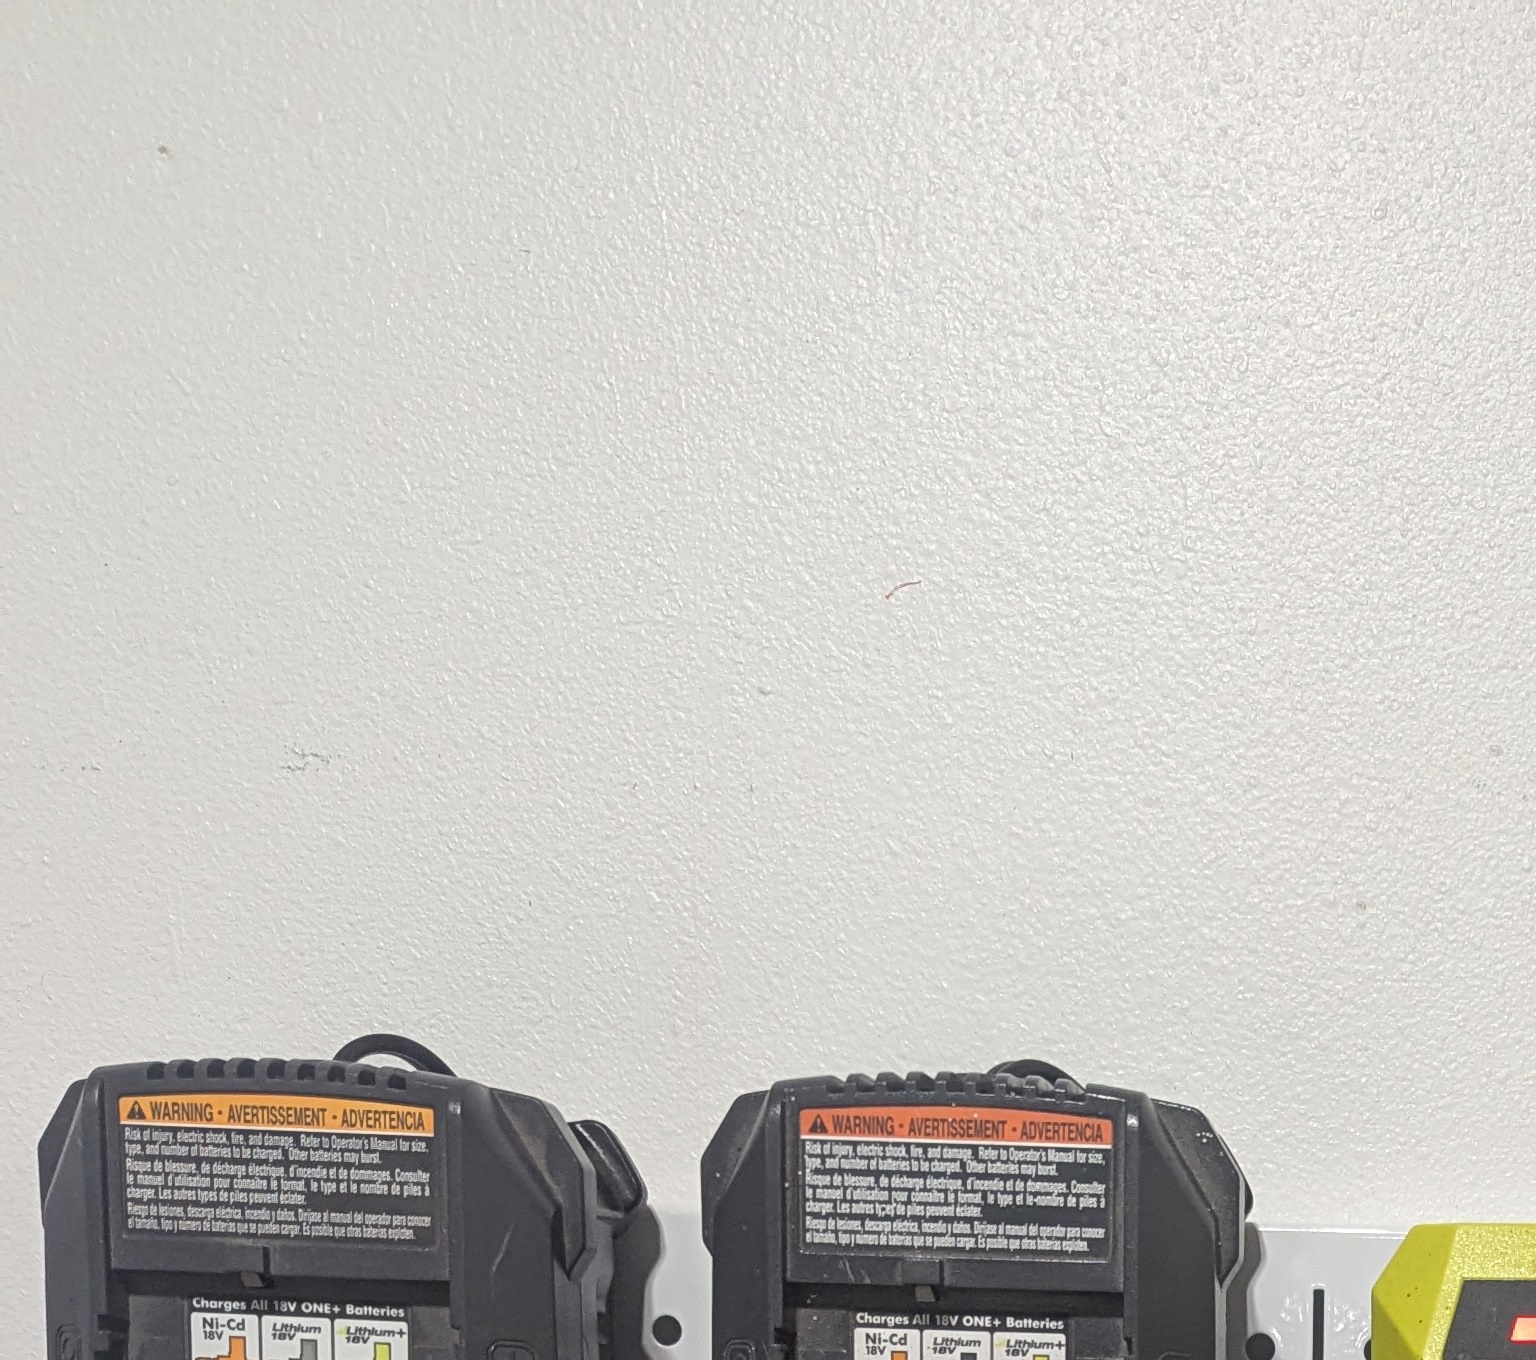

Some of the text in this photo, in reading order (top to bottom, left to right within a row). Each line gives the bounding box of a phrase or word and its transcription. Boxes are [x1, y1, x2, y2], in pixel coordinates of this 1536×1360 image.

[150, 1103, 424, 1130] WARNING AVERTISSEMENT ADVERTENCIA
[832, 1116, 1103, 1141] WARNING AVERTISSEMENT ADVERTENCIA
[192, 1297, 404, 1317] Charges All 18V ONE+ Batteries
[203, 1318, 245, 1331] Ni-Cd
[856, 1313, 1064, 1329] Charges All 18V ONE+ Batteries
[273, 1323, 321, 1334] Lithium
[347, 1327, 406, 1338] Lithium+
[203, 1331, 224, 1340] 18V
[345, 1336, 370, 1344] 18V
[866, 1333, 907, 1345] Ni-Cd
[933, 1337, 981, 1347] Lithium
[1006, 1339, 1065, 1349] Lithium+
[866, 1346, 886, 1355] 18V
[1005, 1349, 1029, 1357] 18V
